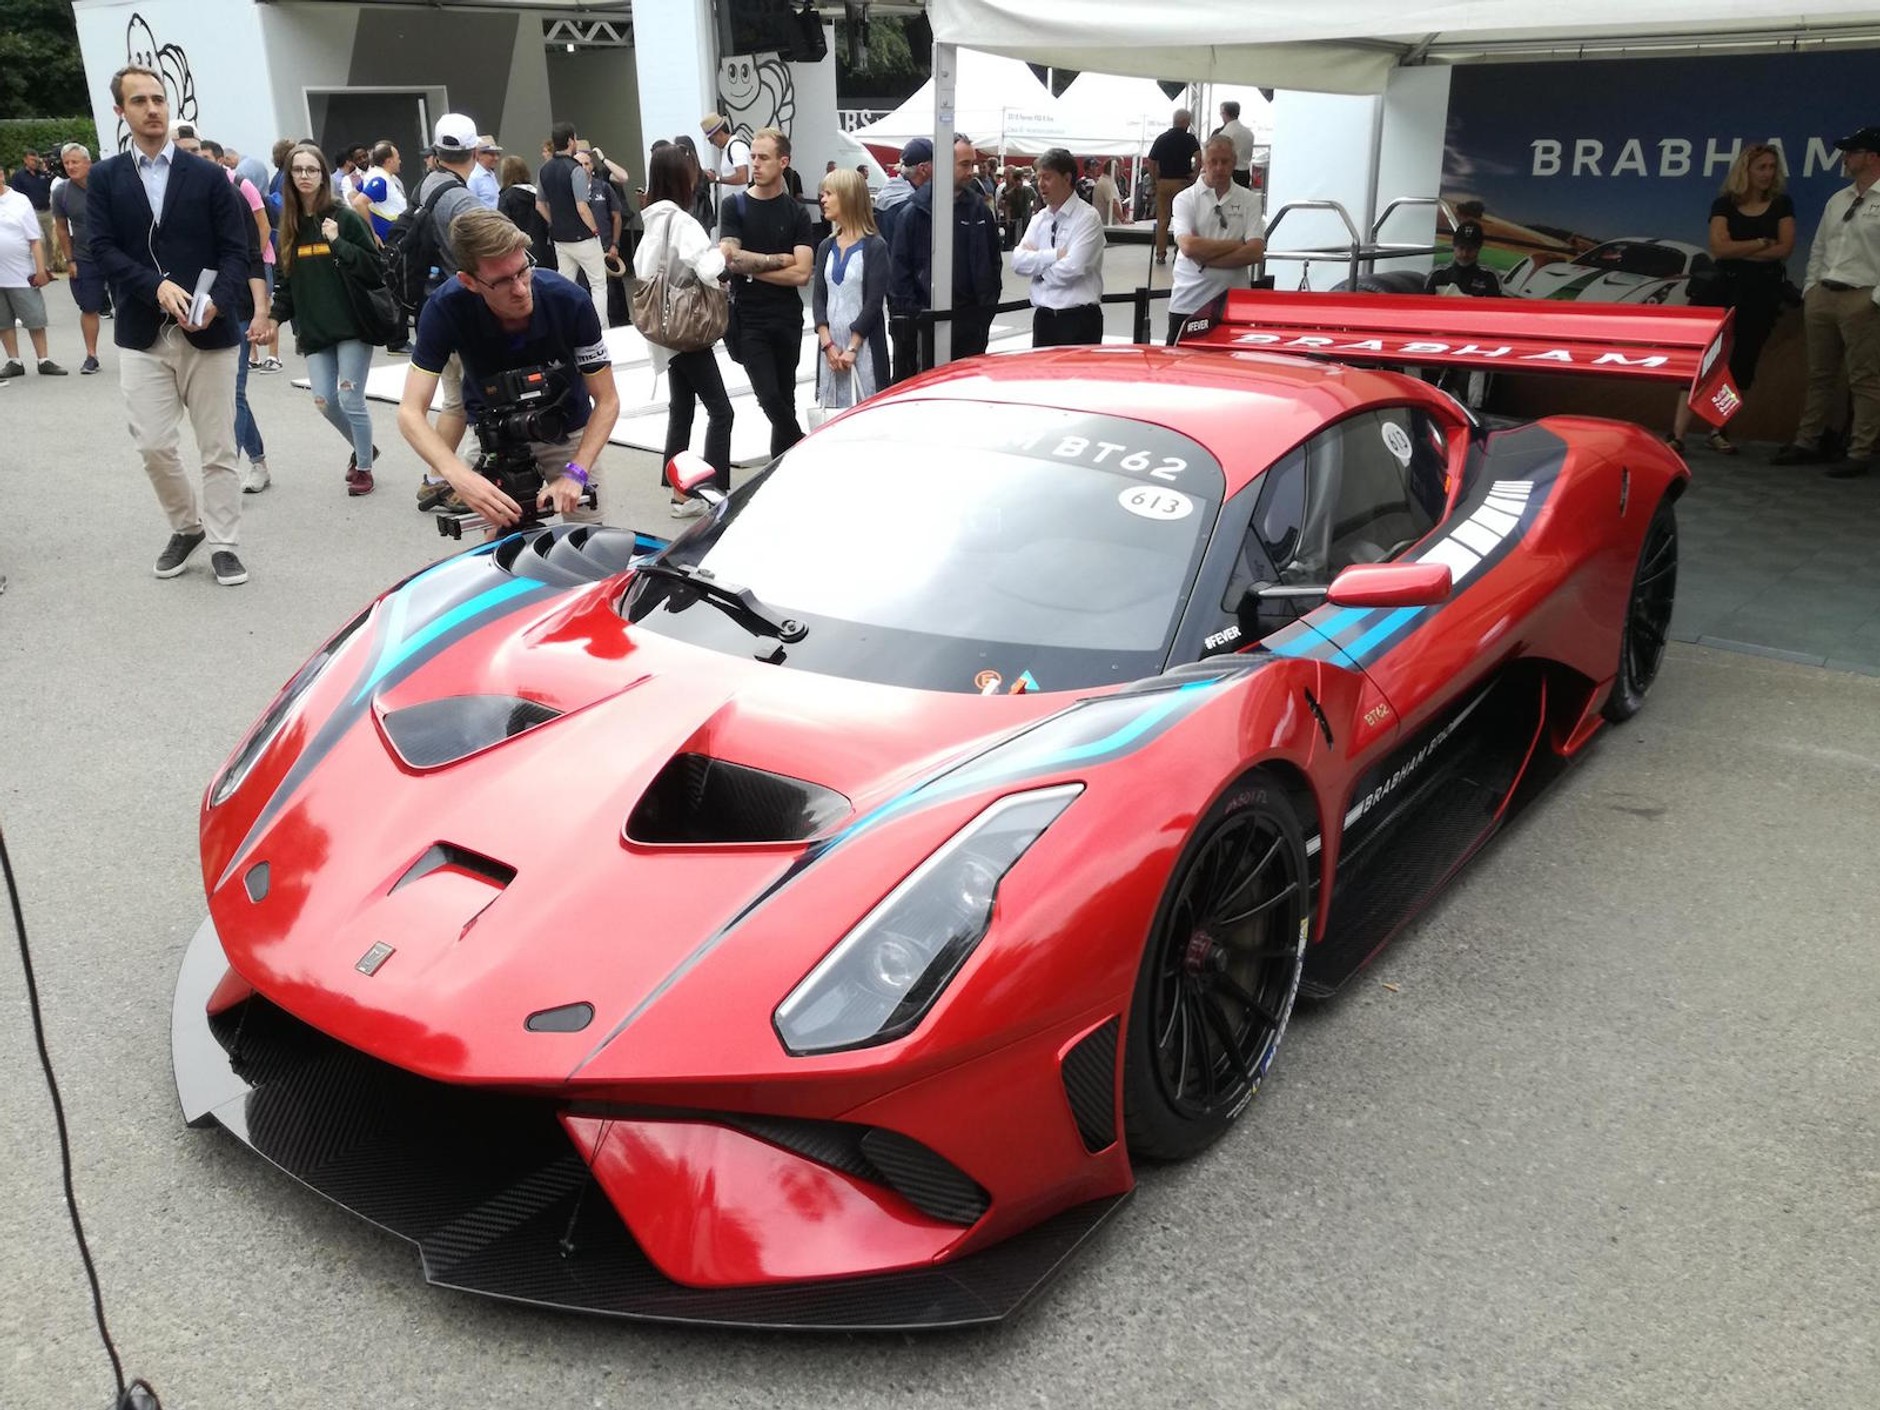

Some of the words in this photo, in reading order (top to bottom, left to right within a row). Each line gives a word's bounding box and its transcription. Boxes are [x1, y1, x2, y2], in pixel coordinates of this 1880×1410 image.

[1187, 319, 1209, 333] #FEVER
[1231, 333, 1669, 368] BRABHAM
[1387, 430, 1408, 451] 613
[1051, 435, 1187, 481] BT62
[1131, 492, 1180, 514] 613
[1204, 625, 1242, 650] #FEVER
[1363, 703, 1390, 727] BT62
[1363, 745, 1428, 814] BRABHAM
